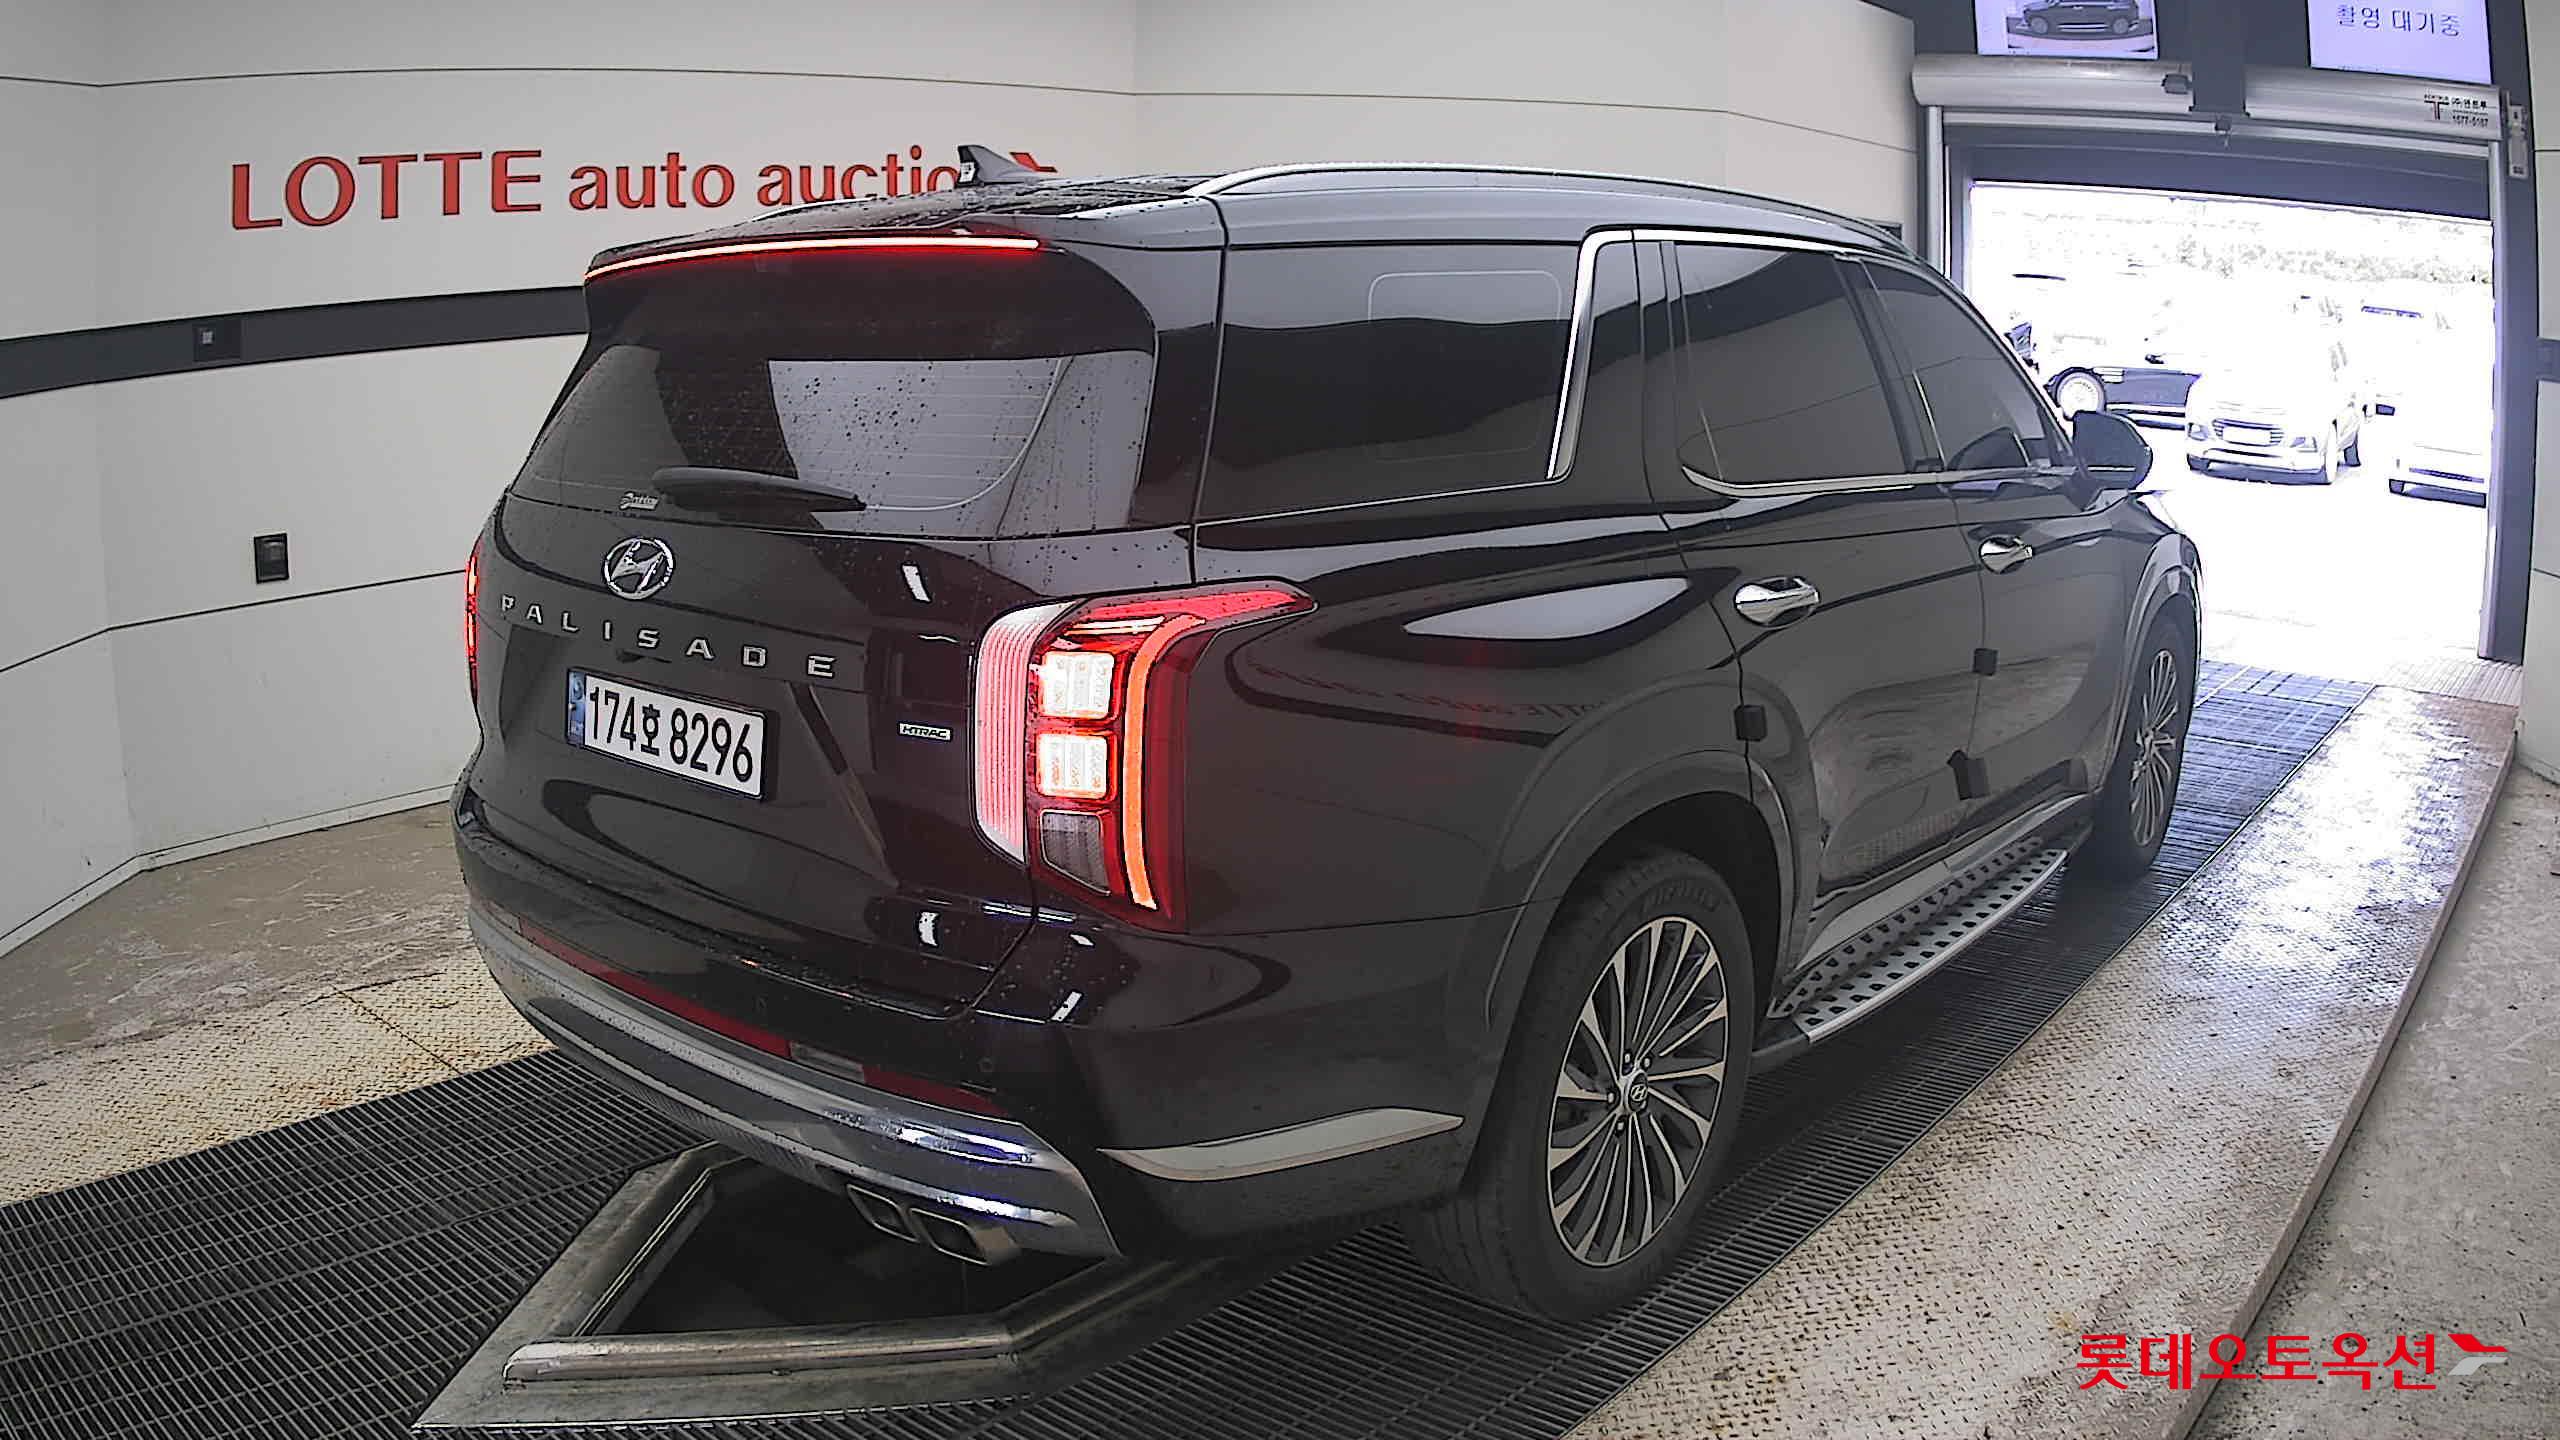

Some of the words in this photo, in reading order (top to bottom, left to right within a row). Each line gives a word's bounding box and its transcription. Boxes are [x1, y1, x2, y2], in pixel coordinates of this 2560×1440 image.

[2338, 4, 2381, 29] 촬영
[2392, 9, 2460, 37] 대기중
[232, 150, 542, 231] LOTTE
[568, 152, 736, 210] auto
[501, 595, 837, 678] PALISADE
[590, 686, 661, 757] 174호
[669, 707, 753, 783] 8296
[901, 725, 948, 739] HTRAC
